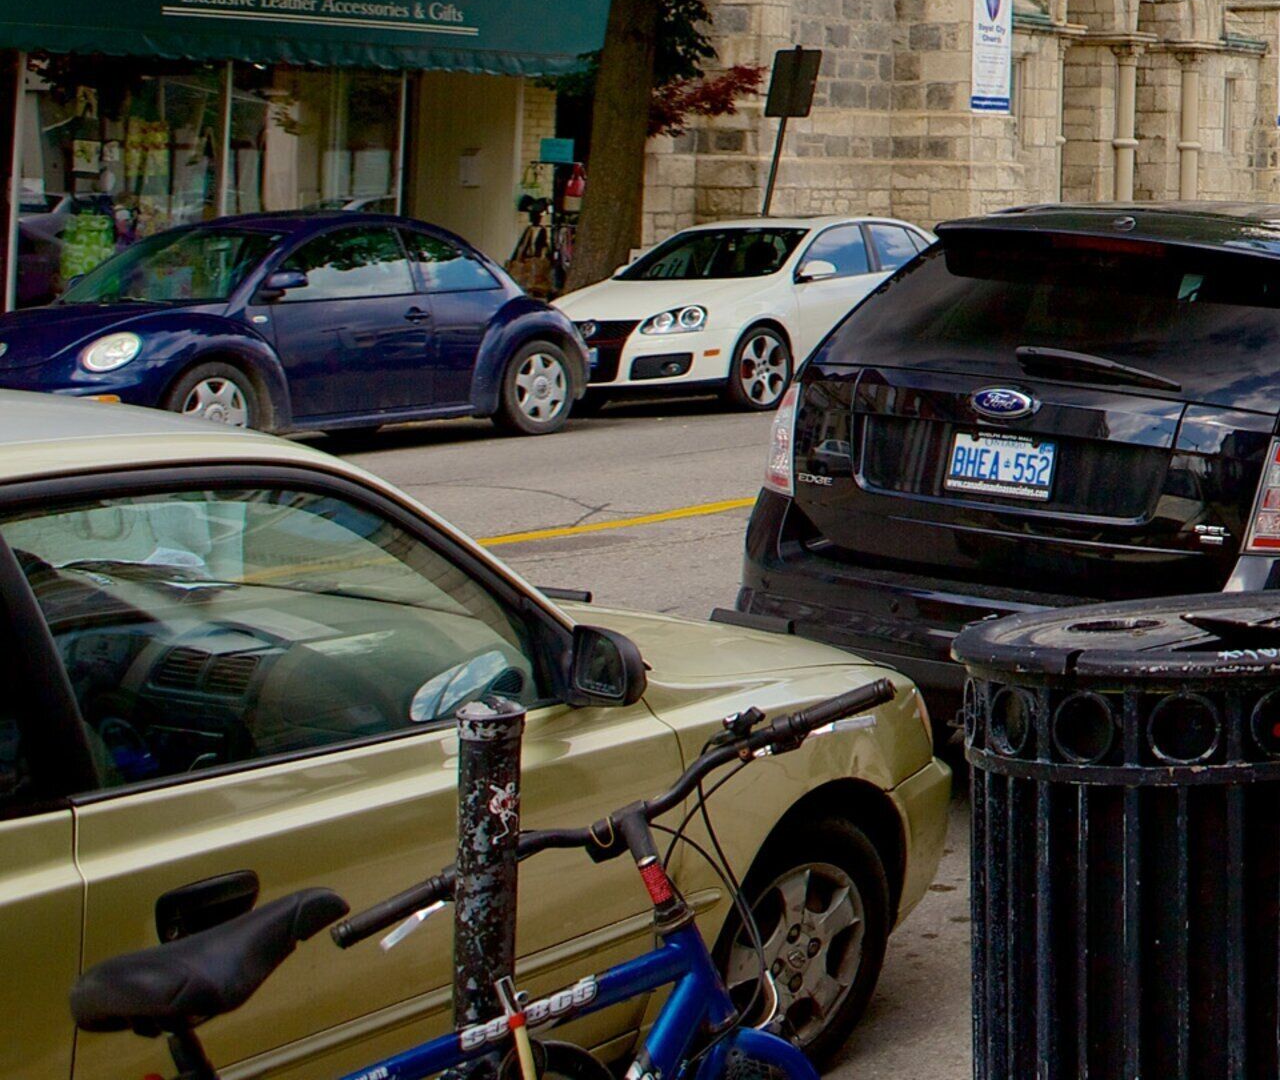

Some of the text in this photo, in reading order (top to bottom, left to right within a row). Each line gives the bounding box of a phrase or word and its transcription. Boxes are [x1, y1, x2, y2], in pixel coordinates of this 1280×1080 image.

[414, 3, 426, 19] &
[429, 1, 465, 22] Gifts
[982, 392, 1017, 410] Ford
[985, 439, 1026, 449] ONTARIO
[951, 445, 1050, 485] BHEA 552
[798, 472, 833, 486] EDGE
